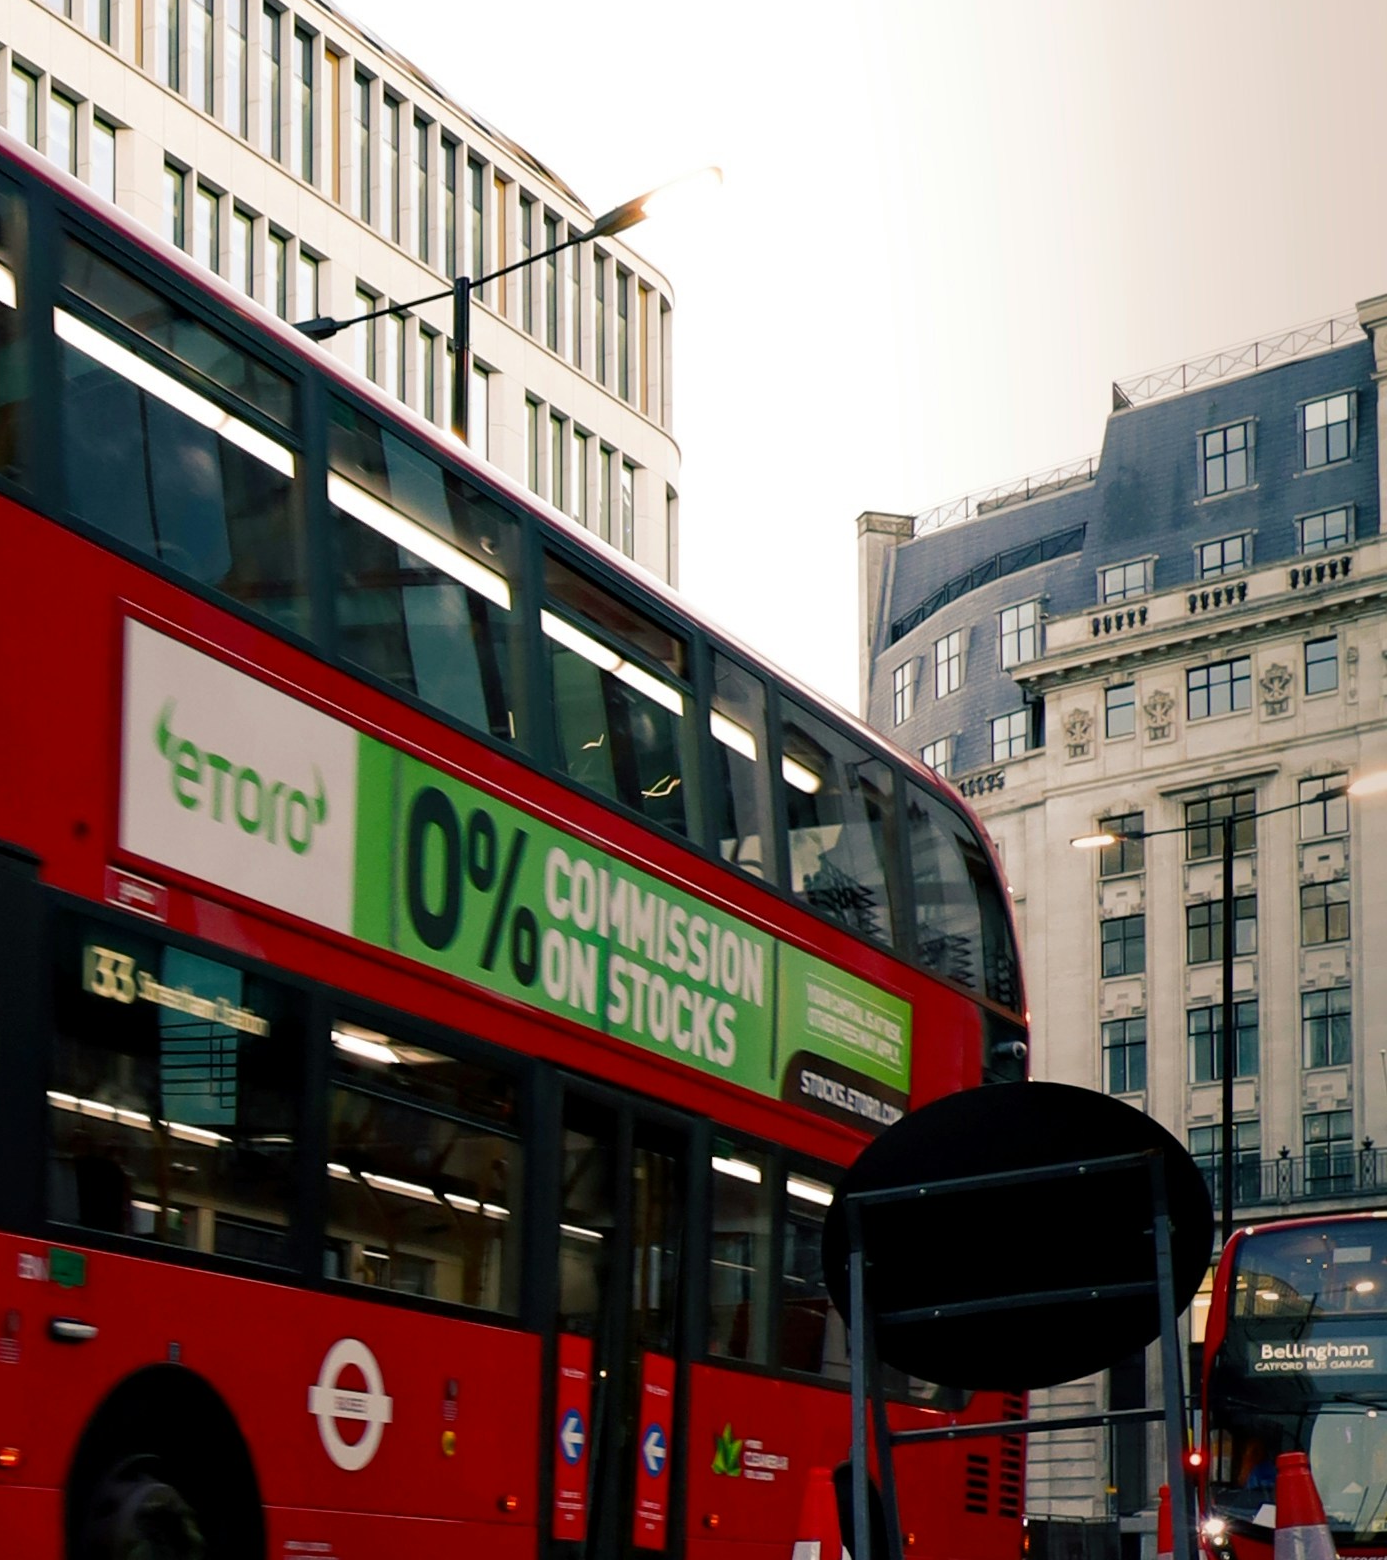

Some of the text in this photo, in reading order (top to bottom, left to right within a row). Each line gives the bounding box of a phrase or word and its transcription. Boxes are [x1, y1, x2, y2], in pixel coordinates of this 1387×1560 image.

[407, 786, 764, 1008] 0% COMMISSION
[541, 927, 737, 1068] ON STOCKS
[1254, 1358, 1375, 1372] CATFORD BUS GARAGE
[1261, 1342, 1369, 1361] Bellingham
